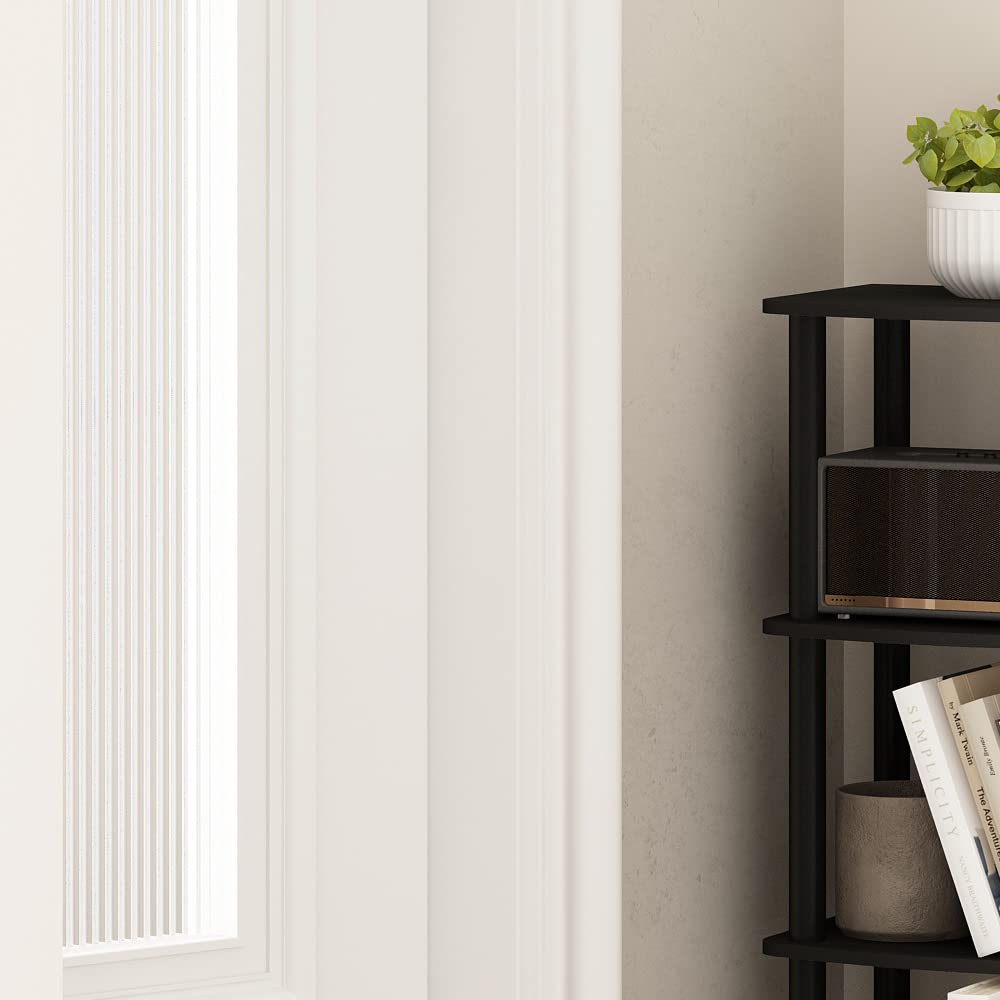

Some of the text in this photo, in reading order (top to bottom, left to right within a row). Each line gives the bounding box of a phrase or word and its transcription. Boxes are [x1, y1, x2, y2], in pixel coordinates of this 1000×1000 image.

[949, 701, 973, 766] by Mark Twain
[906, 704, 960, 839] SIMPLICITY
[986, 758, 996, 776] Emily
[976, 786, 986, 805] The
